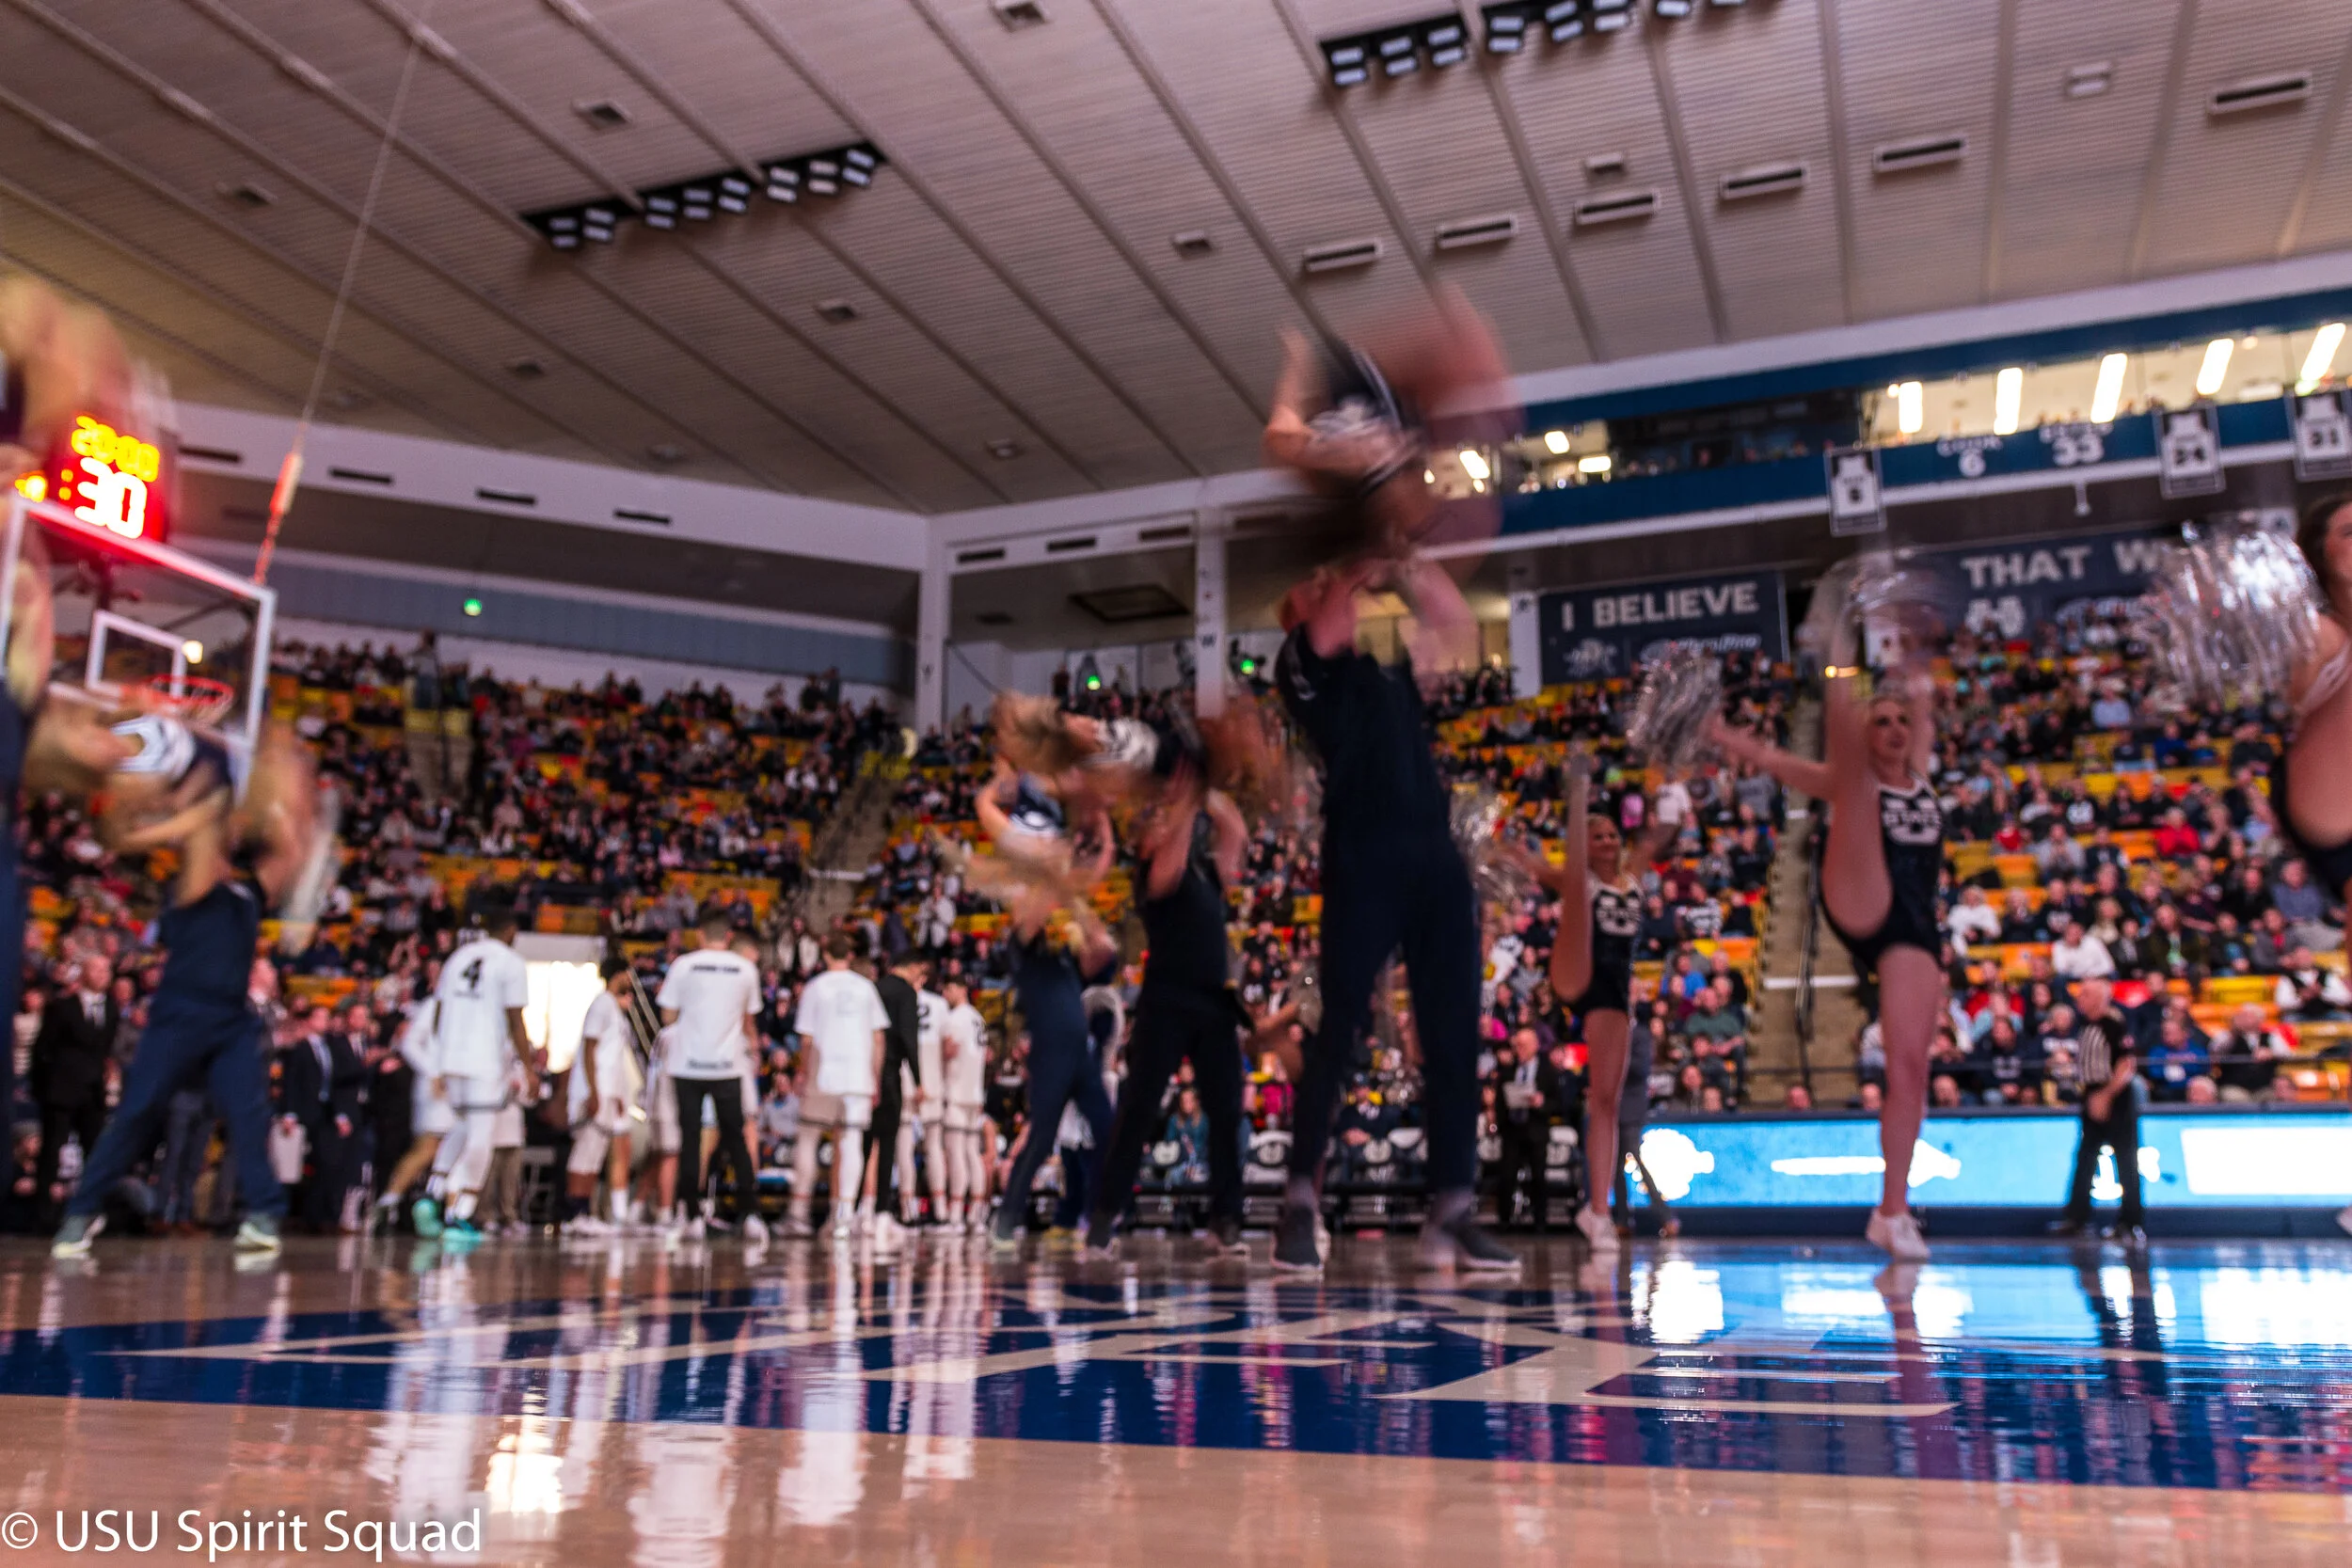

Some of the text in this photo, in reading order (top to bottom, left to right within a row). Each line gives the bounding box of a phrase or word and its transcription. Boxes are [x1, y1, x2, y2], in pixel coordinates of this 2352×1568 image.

[74, 457, 147, 539] 30
[1961, 545, 2092, 590] THAT
[1562, 581, 1761, 632] I BELIEVE
[461, 958, 483, 990] 4
